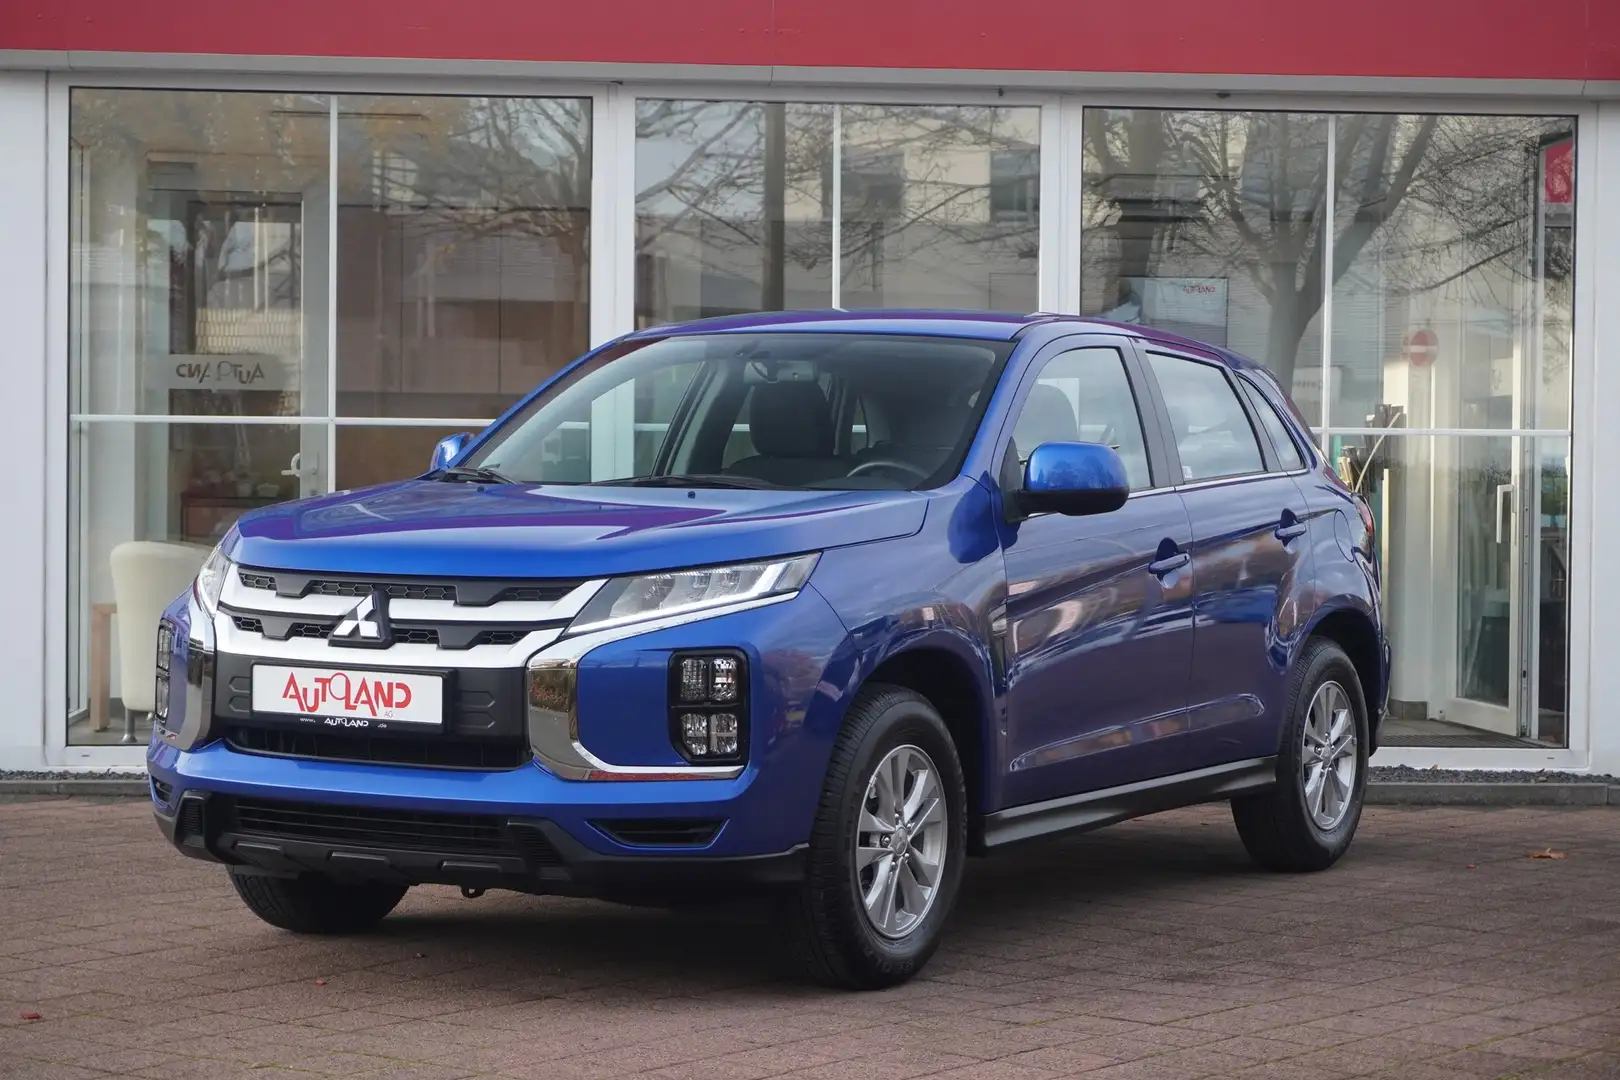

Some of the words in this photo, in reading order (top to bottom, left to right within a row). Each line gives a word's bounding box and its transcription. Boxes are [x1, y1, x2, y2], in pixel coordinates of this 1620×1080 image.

[282, 671, 412, 717] AUTOLAND
[384, 710, 394, 719] AG
[324, 717, 369, 728] AUTOLAND
